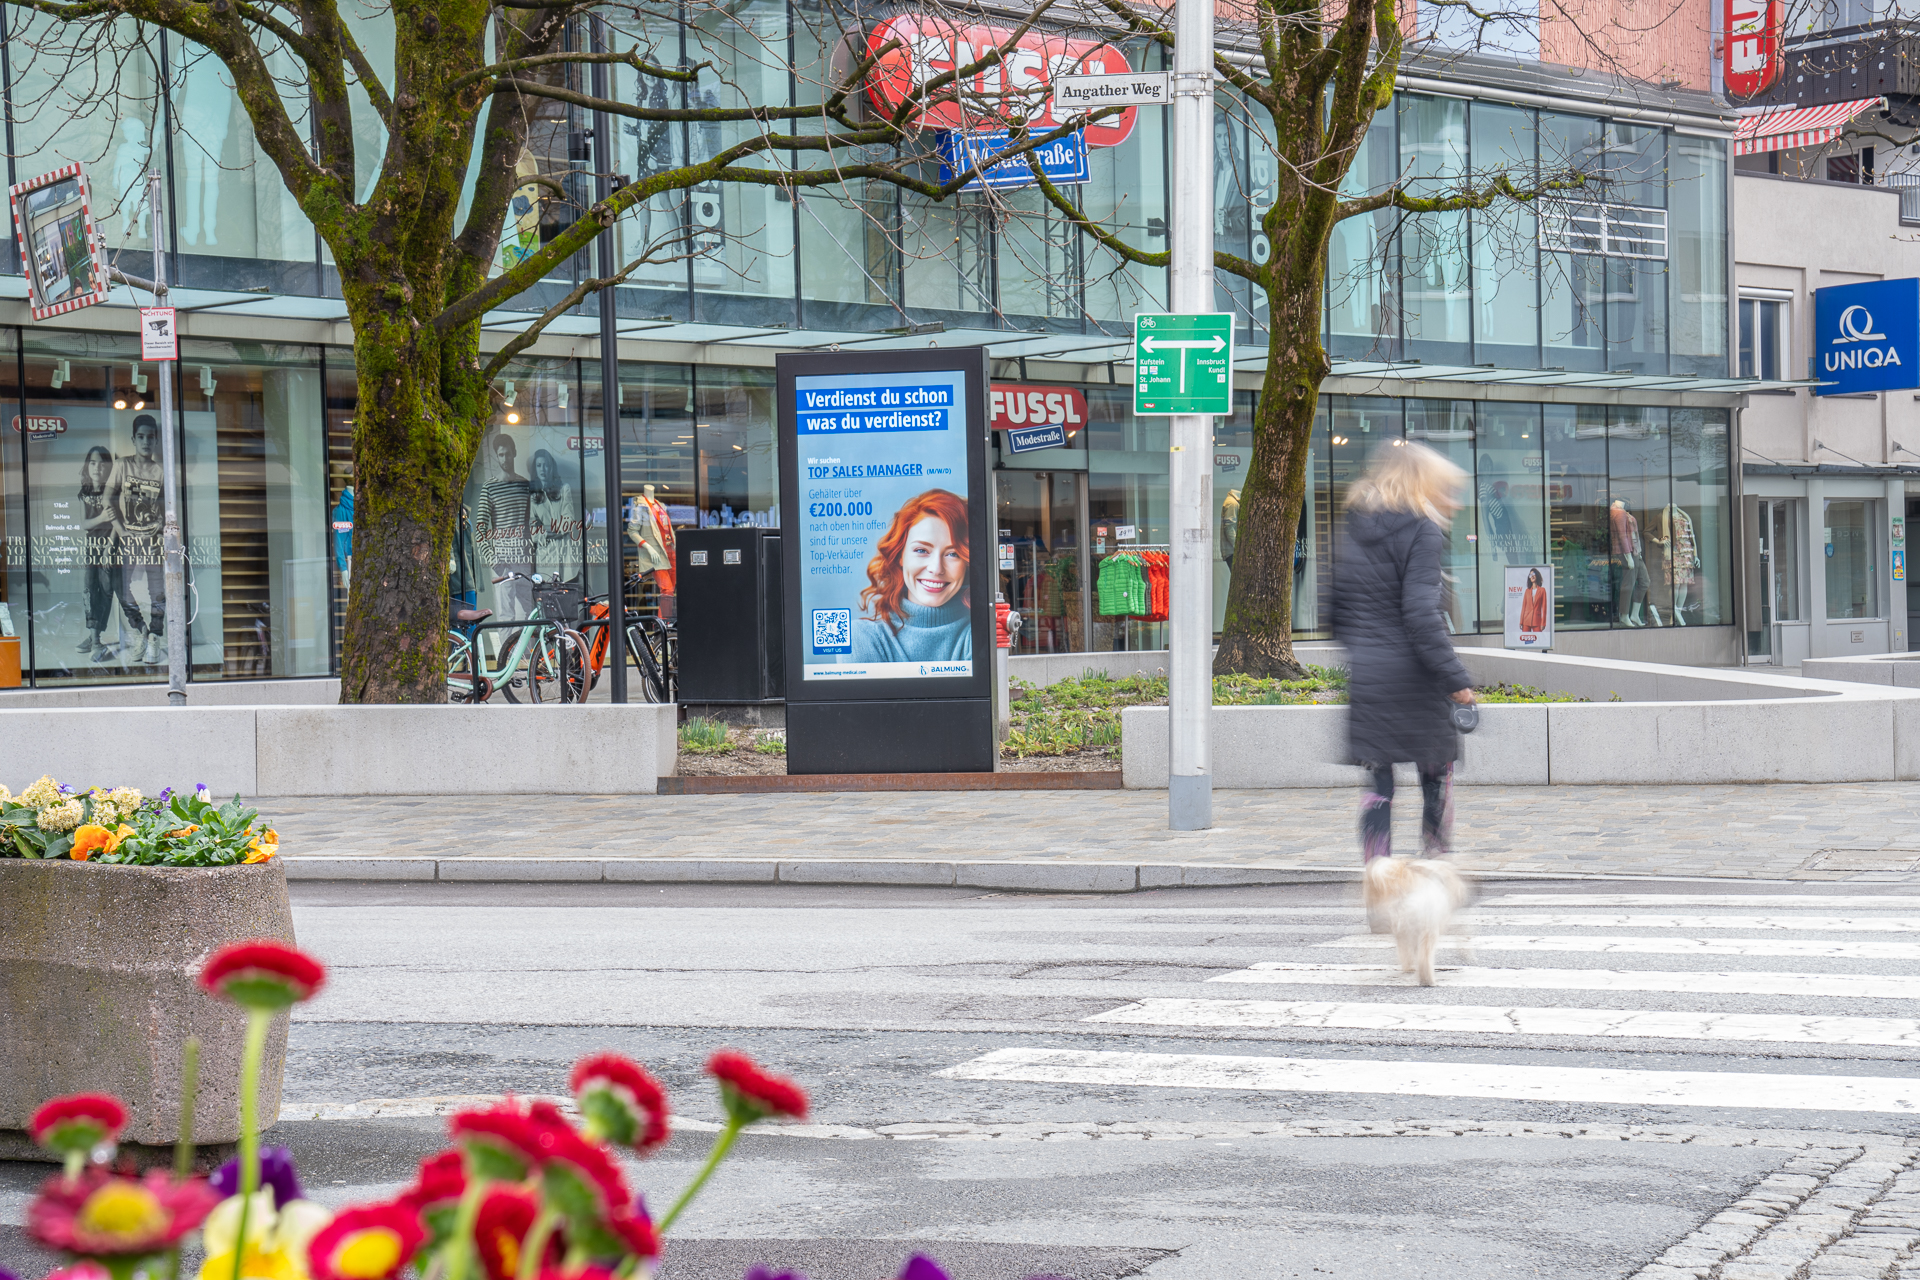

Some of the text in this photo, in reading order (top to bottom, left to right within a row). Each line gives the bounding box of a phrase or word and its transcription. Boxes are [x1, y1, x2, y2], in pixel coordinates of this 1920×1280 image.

[1062, 82, 1161, 100] Angather Weg
[1825, 346, 1902, 372] UNIQA
[806, 388, 948, 407] Verdienst du schon
[990, 392, 1081, 424] FUSSL
[806, 411, 942, 430] was du verdienst?
[1016, 430, 1060, 446] Modestraße
[1217, 456, 1239, 465] FUSSL
[808, 466, 829, 478] TOP
[833, 465, 863, 477] SALES
[867, 464, 923, 476] MANAGER
[809, 488, 862, 499] Gehälter über
[809, 502, 872, 517] €200.000
[530, 520, 546, 535] in
[810, 520, 886, 532] nach oben hin offen
[120, 536, 144, 546] NEW
[810, 535, 867, 546] sind für unsere
[7, 546, 50, 556] YONG
[108, 546, 155, 556] CASUAL
[810, 549, 864, 562] Top-Verkäufer
[76, 556, 124, 565] COLOUR
[811, 564, 852, 574] erreichbar.
